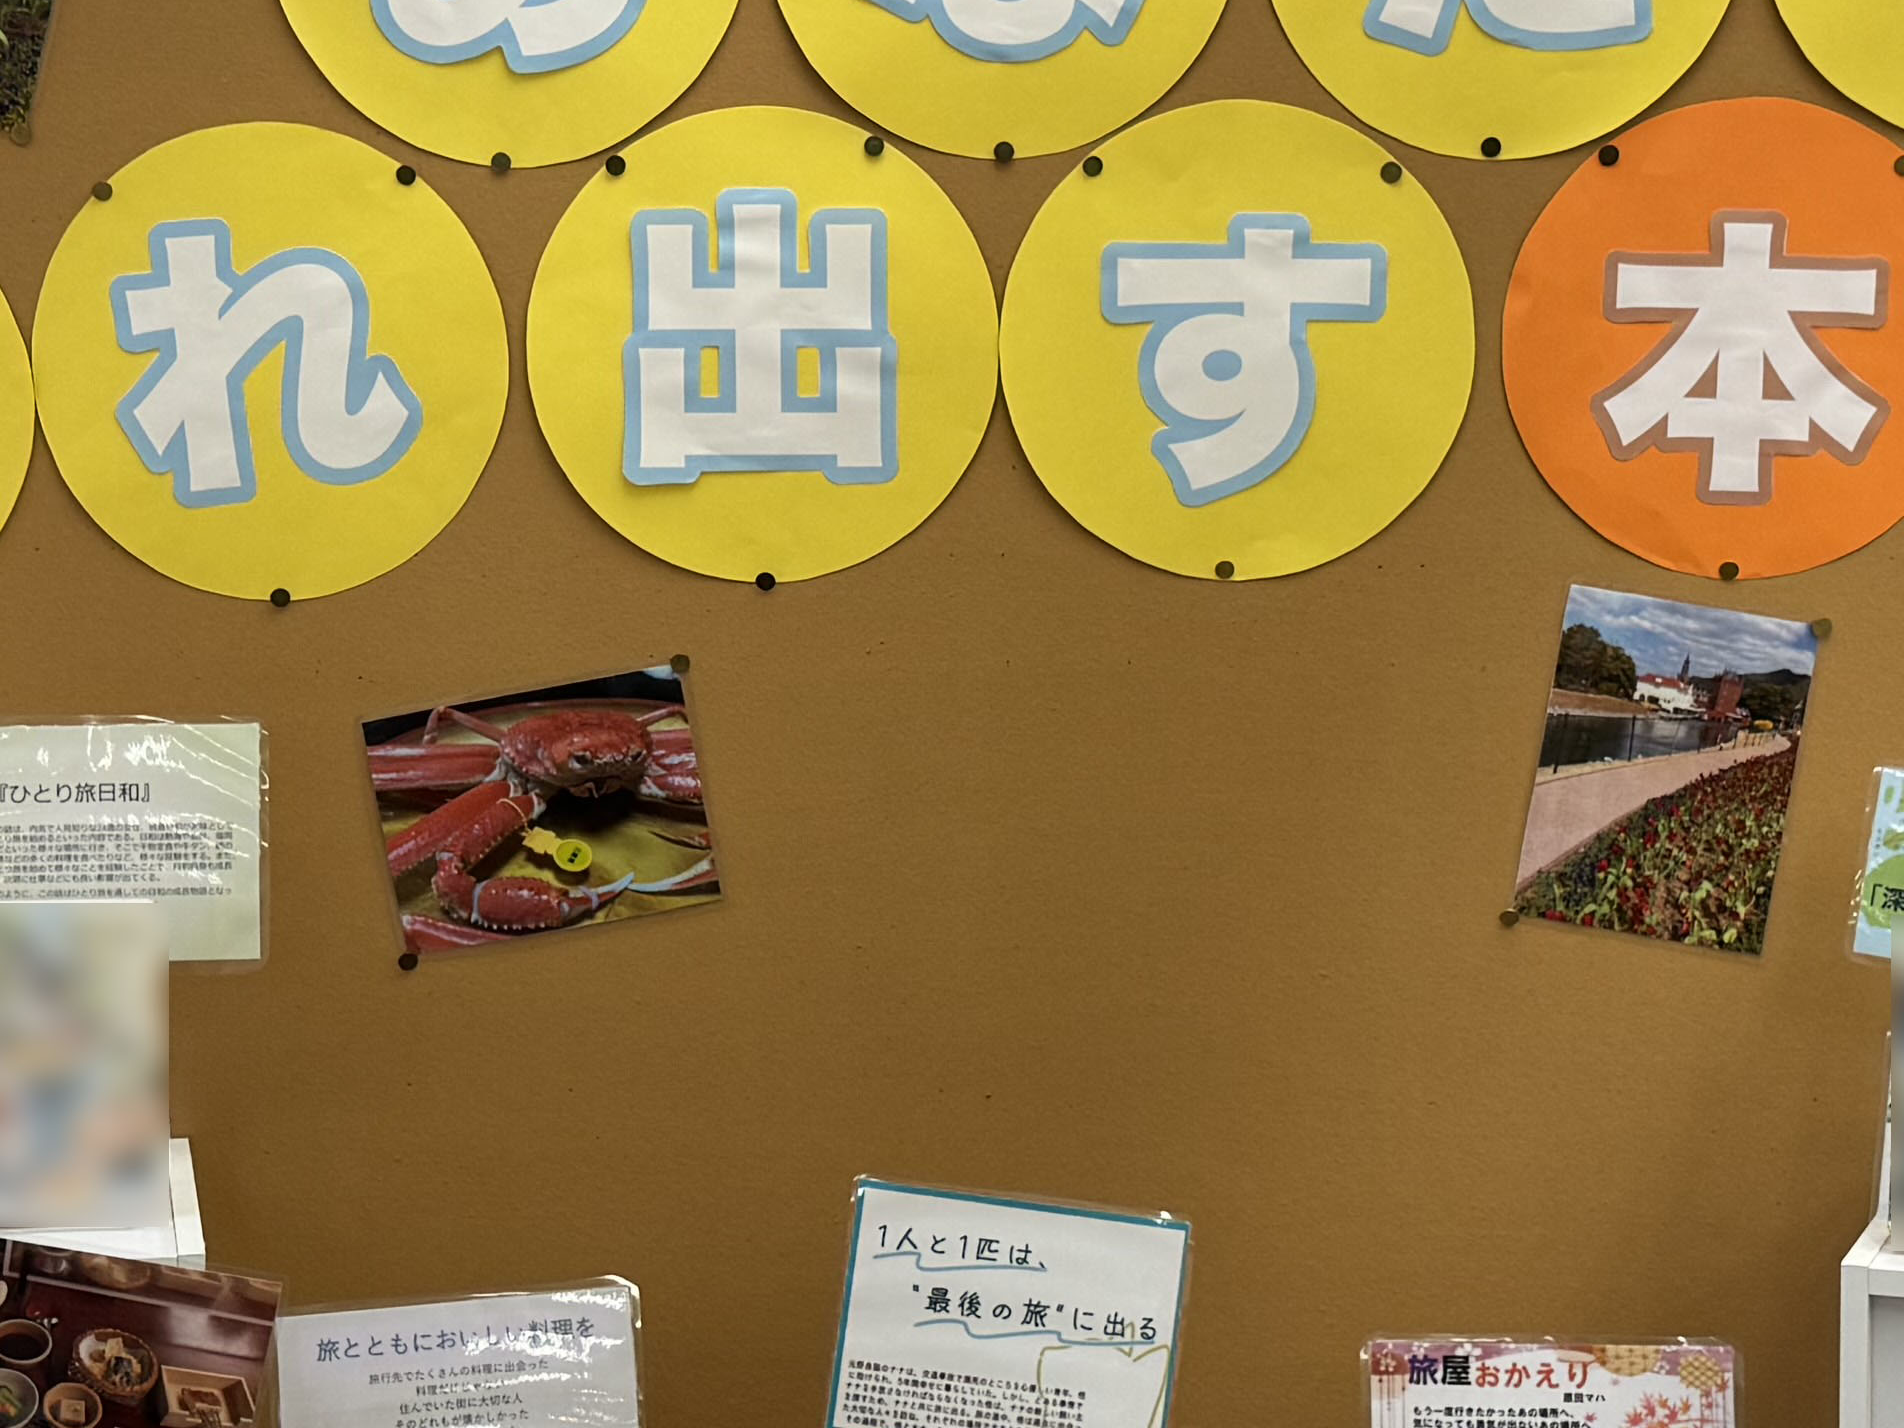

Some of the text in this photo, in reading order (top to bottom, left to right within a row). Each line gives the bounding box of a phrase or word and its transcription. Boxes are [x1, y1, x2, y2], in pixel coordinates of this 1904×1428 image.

[0, 782, 150, 803] 『ひとり旅日和』
[877, 1224, 1047, 1269] 1人と1匹は、
[1407, 1355, 1592, 1390] 旅屋おかえり
